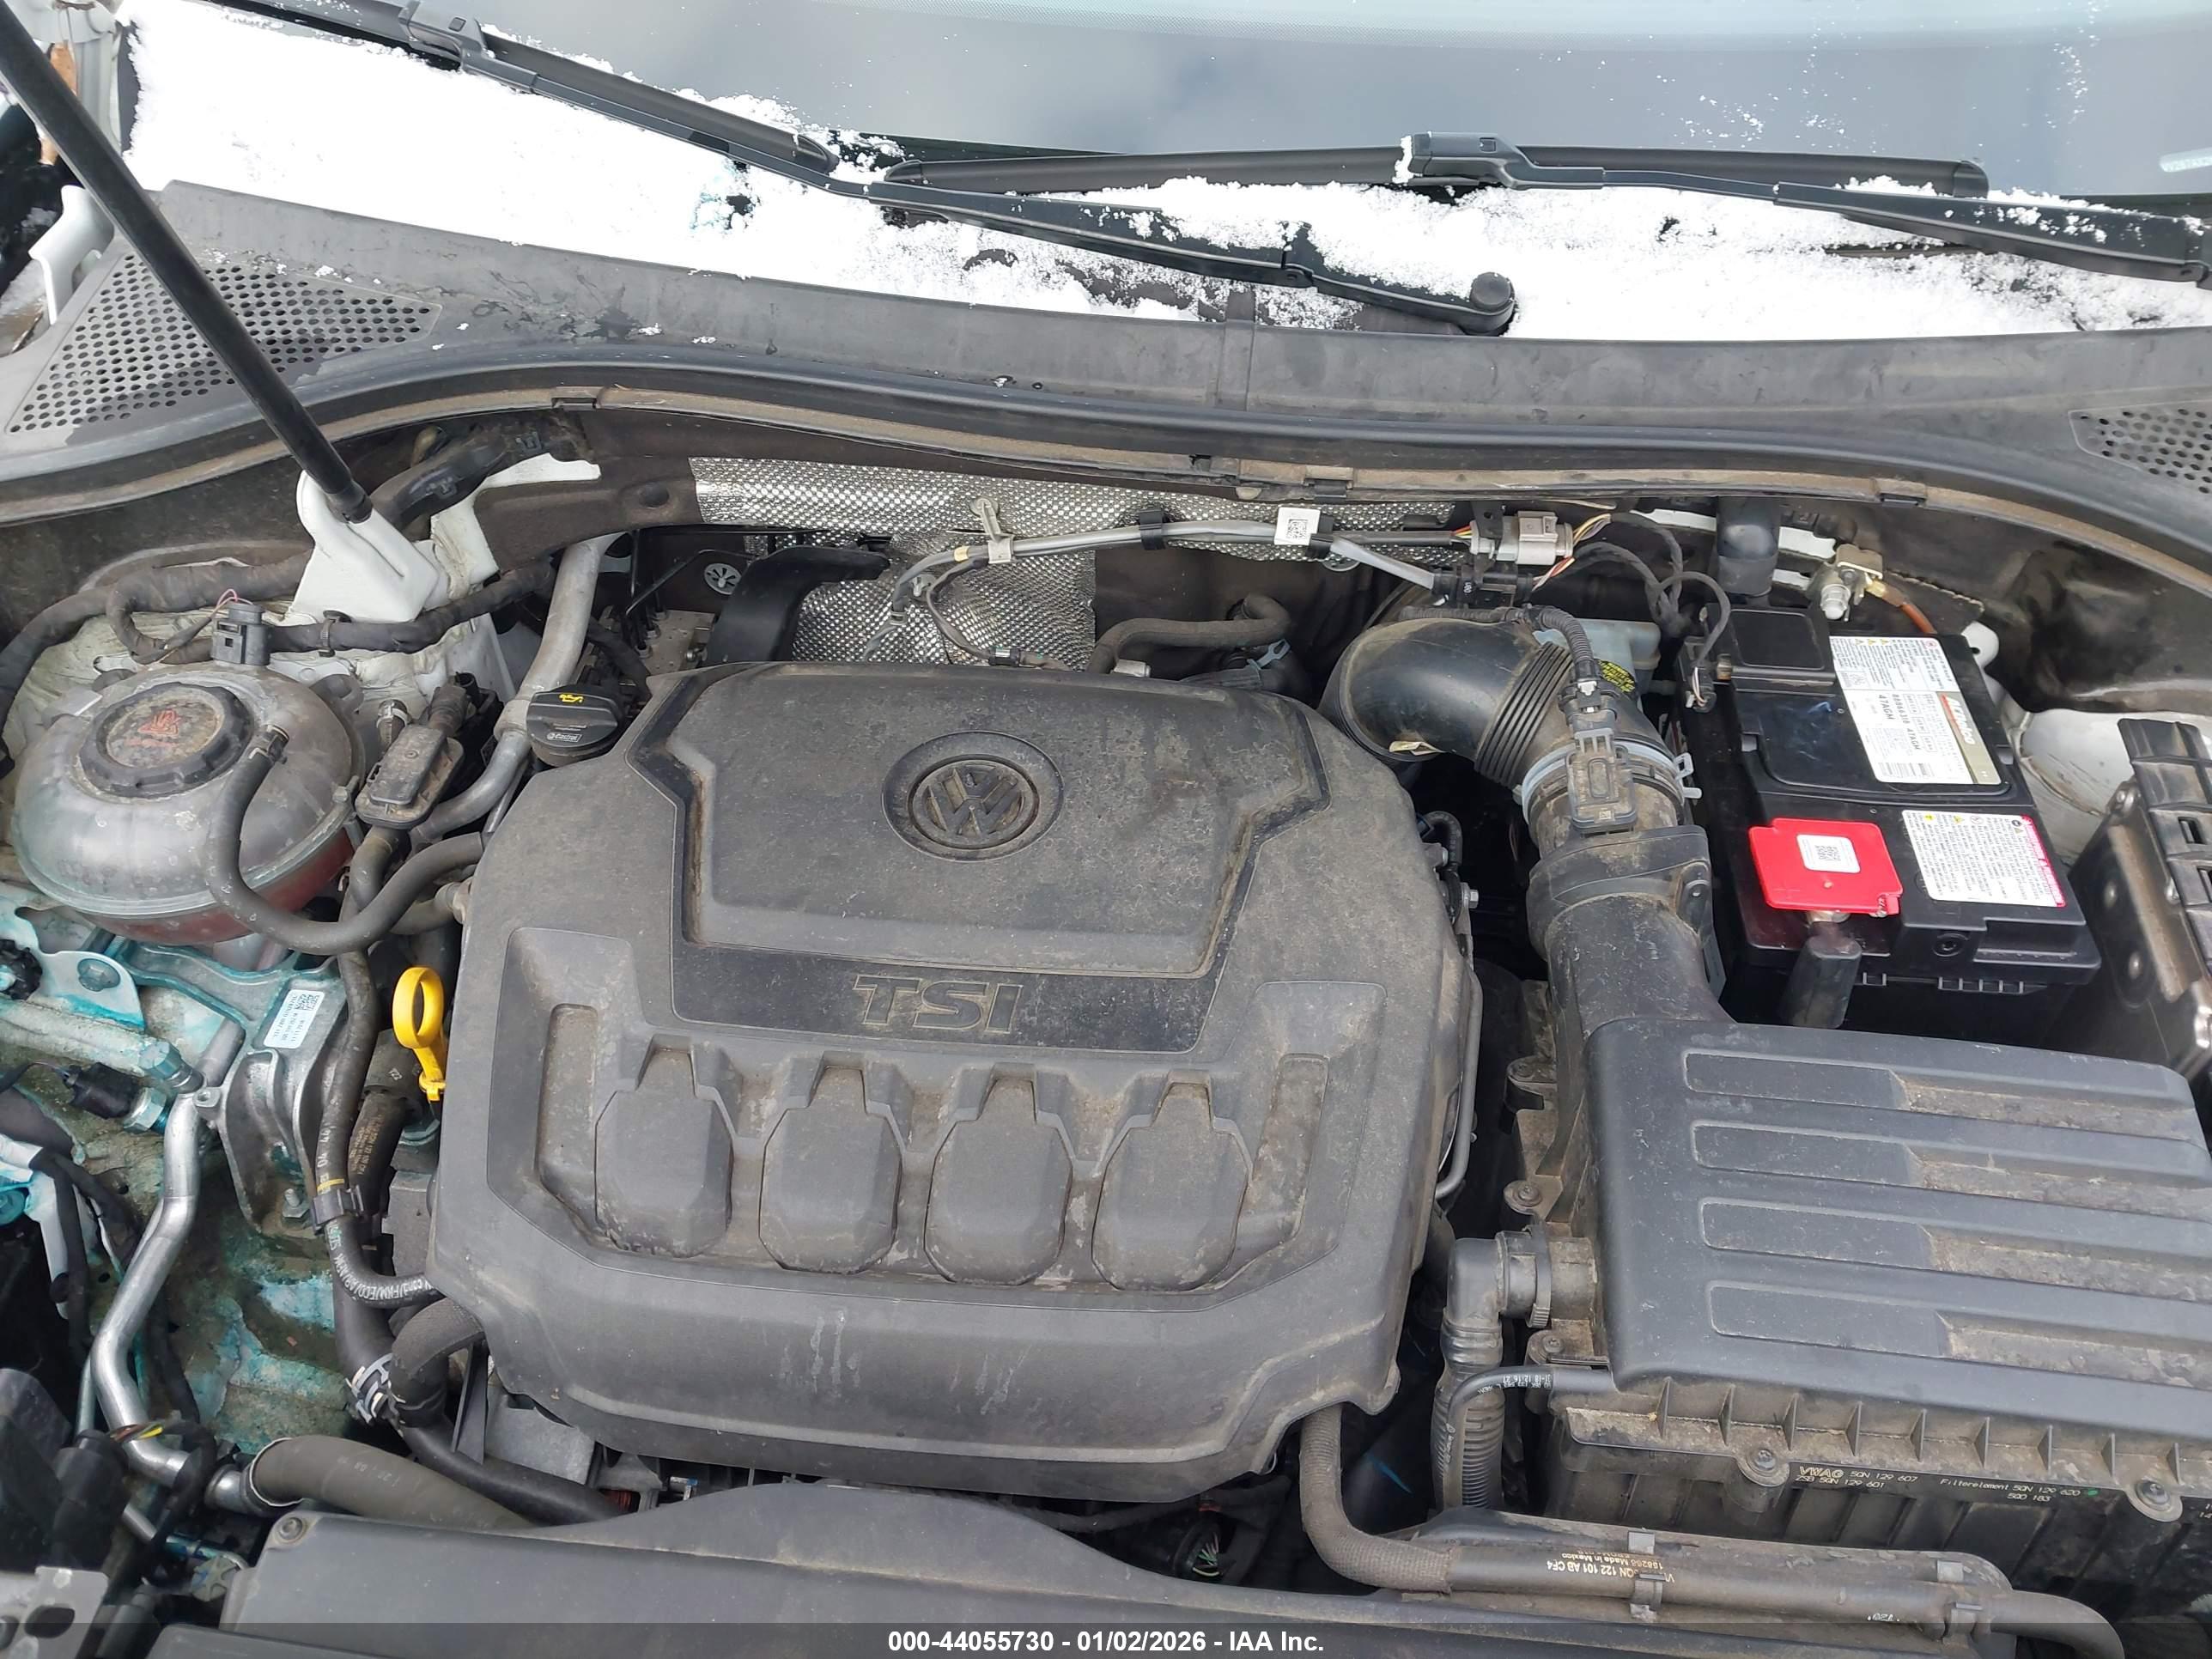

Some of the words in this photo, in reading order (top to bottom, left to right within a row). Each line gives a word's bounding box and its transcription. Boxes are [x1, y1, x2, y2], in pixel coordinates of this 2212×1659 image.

[1879, 694, 1895, 720] 47AGM
[1907, 728, 1921, 750] 47AGM
[853, 975, 1024, 1034] TSI
[1799, 1466, 1844, 1478] VWAG
[1940, 1478, 2009, 1491] Filterelement
[1561, 1553, 1593, 1563] Mexico
[1594, 1553, 1603, 1563] in
[1603, 1555, 1630, 1565] Made
[1547, 1559, 1565, 1571] CF4
[1566, 1560, 1581, 1572] AB
[1583, 1561, 1598, 1574] 101
[1601, 1564, 1617, 1576] 122
